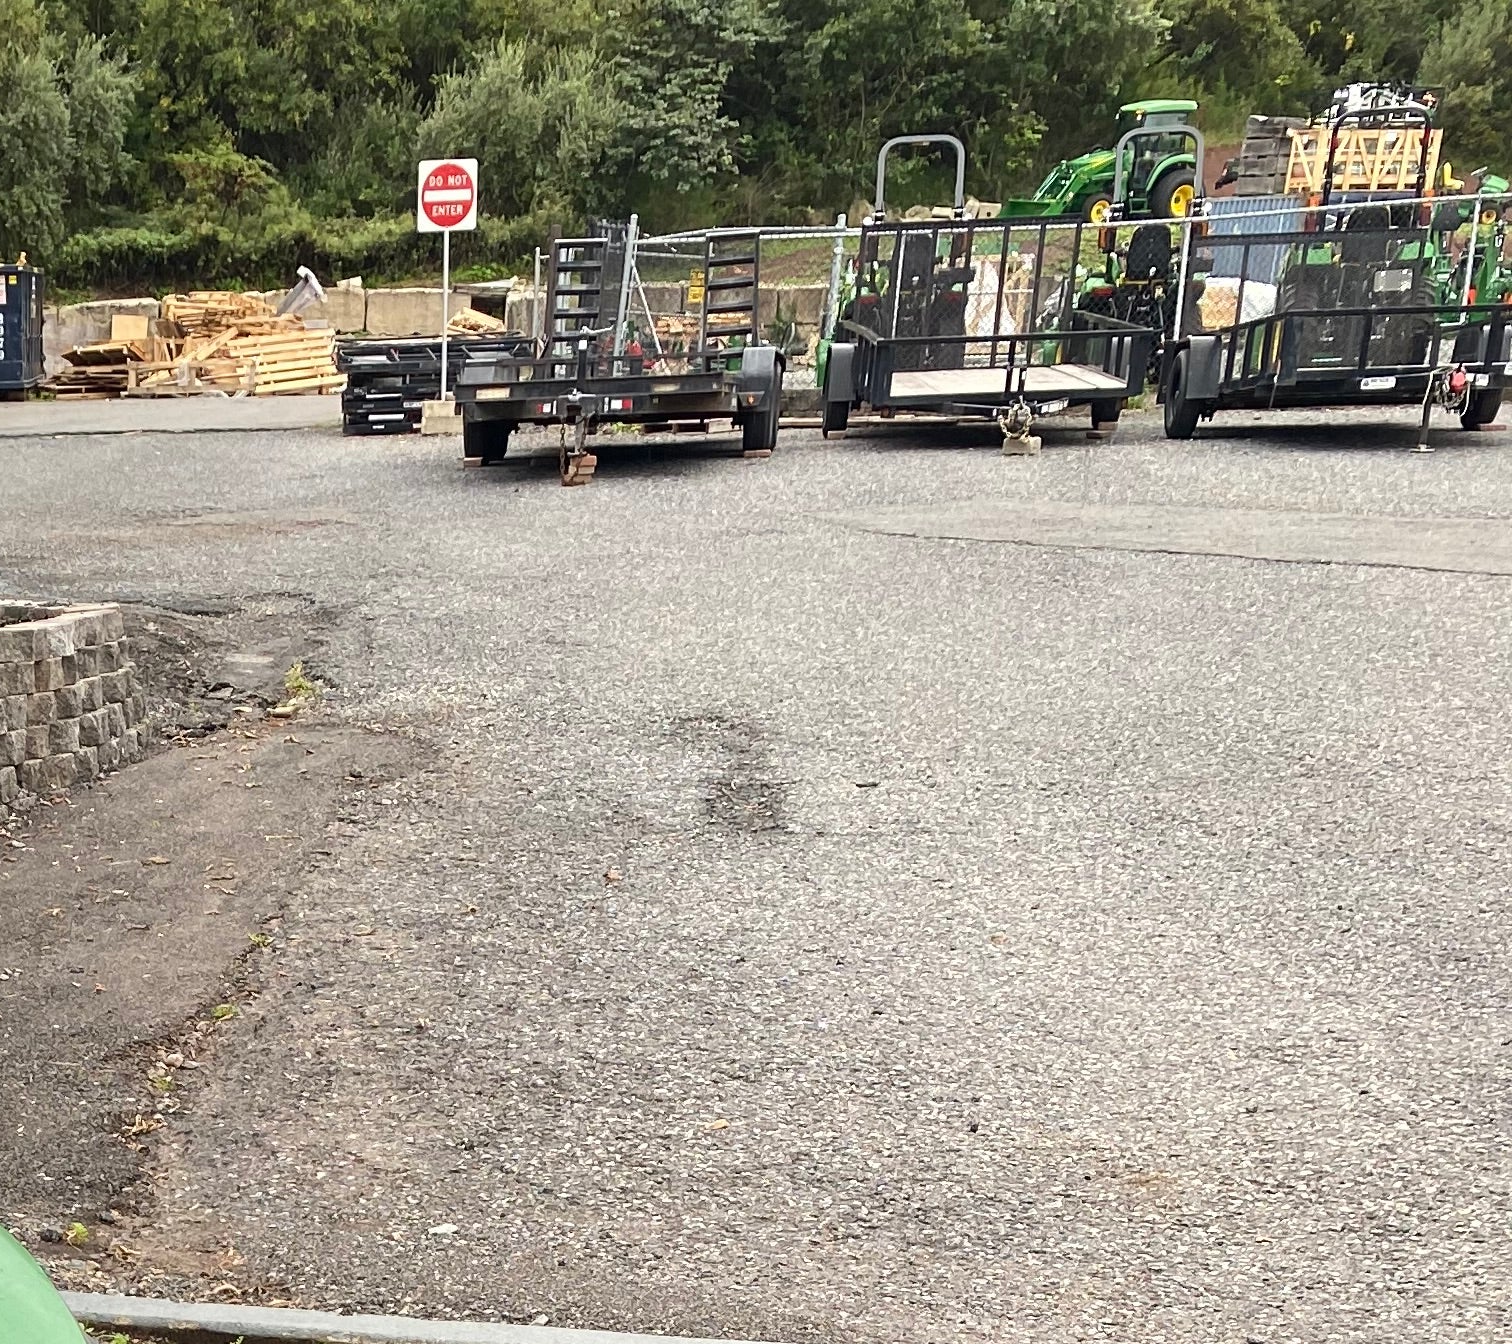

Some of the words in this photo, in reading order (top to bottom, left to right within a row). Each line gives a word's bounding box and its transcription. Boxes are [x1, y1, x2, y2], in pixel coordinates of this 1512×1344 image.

[429, 175, 443, 187] DO
[448, 174, 468, 186] NOT
[431, 204, 464, 217] ENTER
